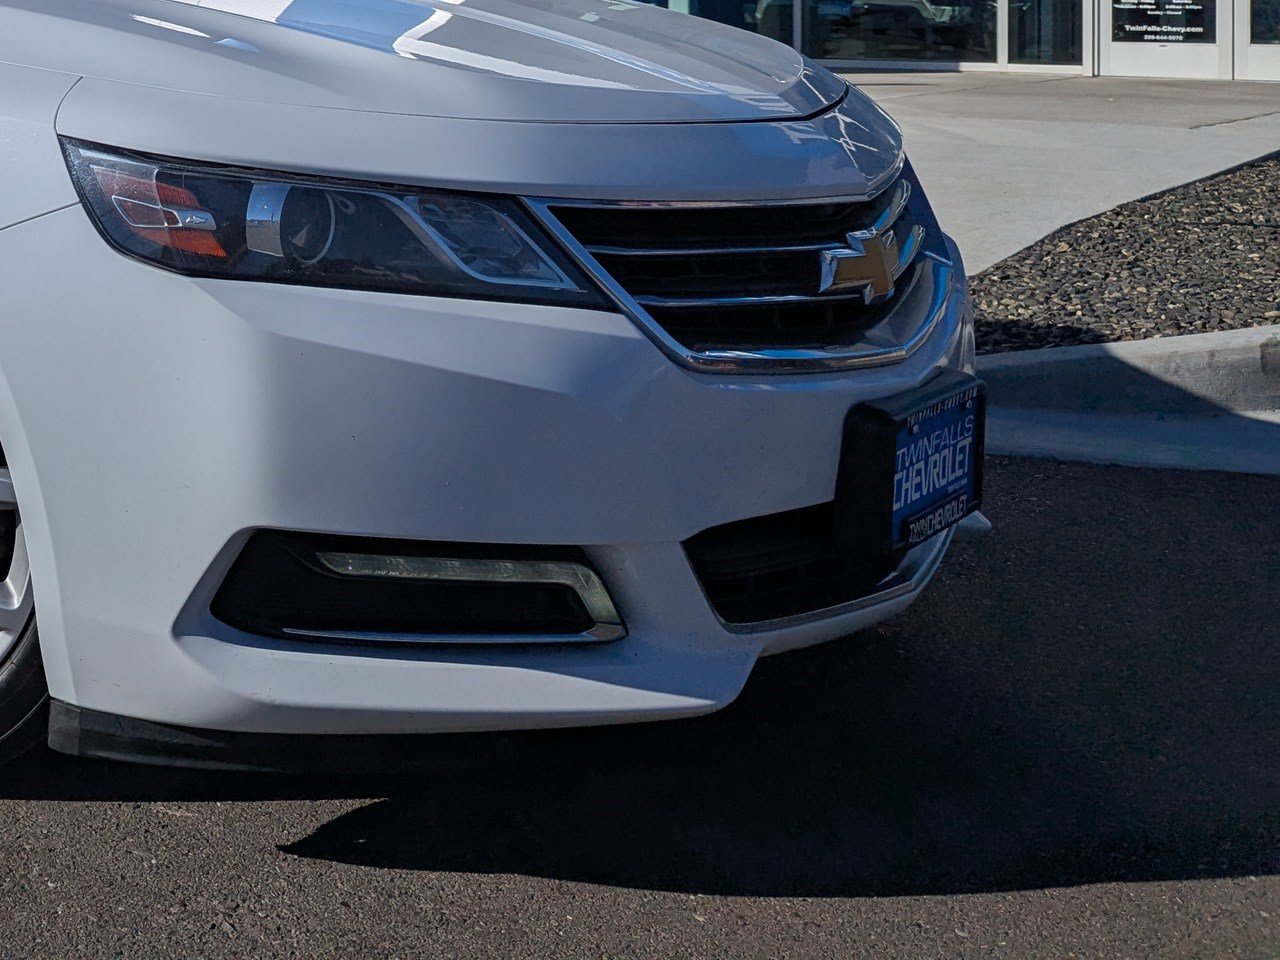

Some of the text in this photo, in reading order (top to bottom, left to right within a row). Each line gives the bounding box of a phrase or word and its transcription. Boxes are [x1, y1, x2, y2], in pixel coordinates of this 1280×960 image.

[1125, 25, 1203, 33] TwinFalls-Chevy.com
[896, 414, 974, 471] TWINFALLS
[892, 436, 973, 511] CHEVROLET
